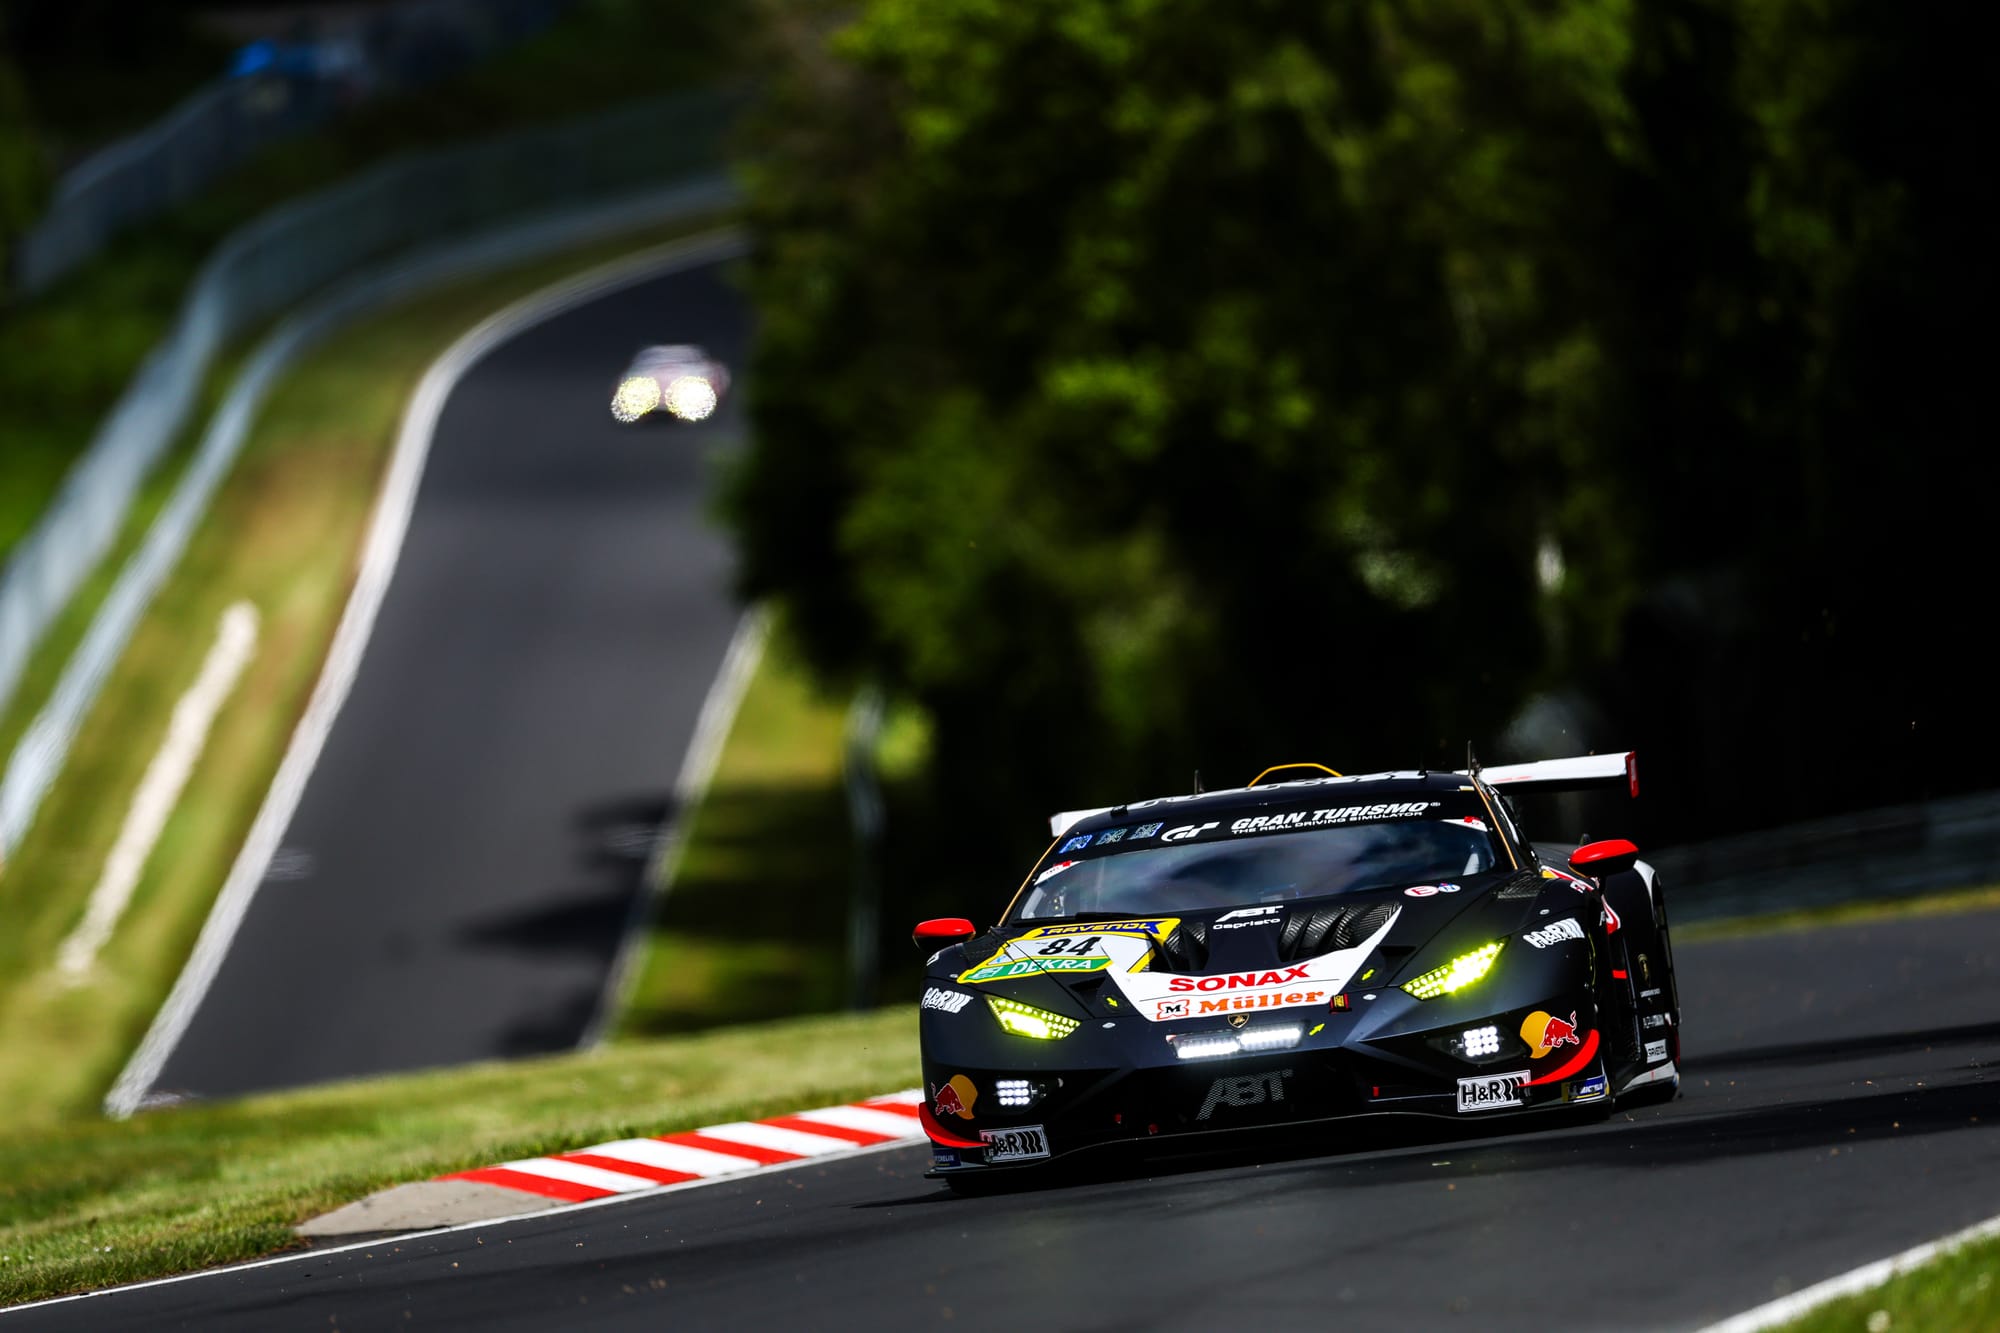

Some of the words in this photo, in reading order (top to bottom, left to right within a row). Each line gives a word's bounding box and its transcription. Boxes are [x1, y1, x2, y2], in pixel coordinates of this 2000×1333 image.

[1231, 812, 1307, 830] GRAN
[1312, 802, 1429, 821] TURISMO
[1231, 827, 1257, 835] THE
[1260, 824, 1293, 832] REAL
[1295, 818, 1346, 827] DRIVING
[1349, 812, 1423, 821] SIMULATOR
[1047, 922, 1151, 935] RAVENOL
[1037, 936, 1102, 956] 84
[1008, 959, 1092, 975] DEKRA
[1169, 964, 1311, 992] SONAX
[1165, 1004, 1181, 1014] M
[1198, 991, 1325, 1014] Müller
[1461, 1080, 1505, 1106] H&R
[982, 1132, 1020, 1158] H&R
